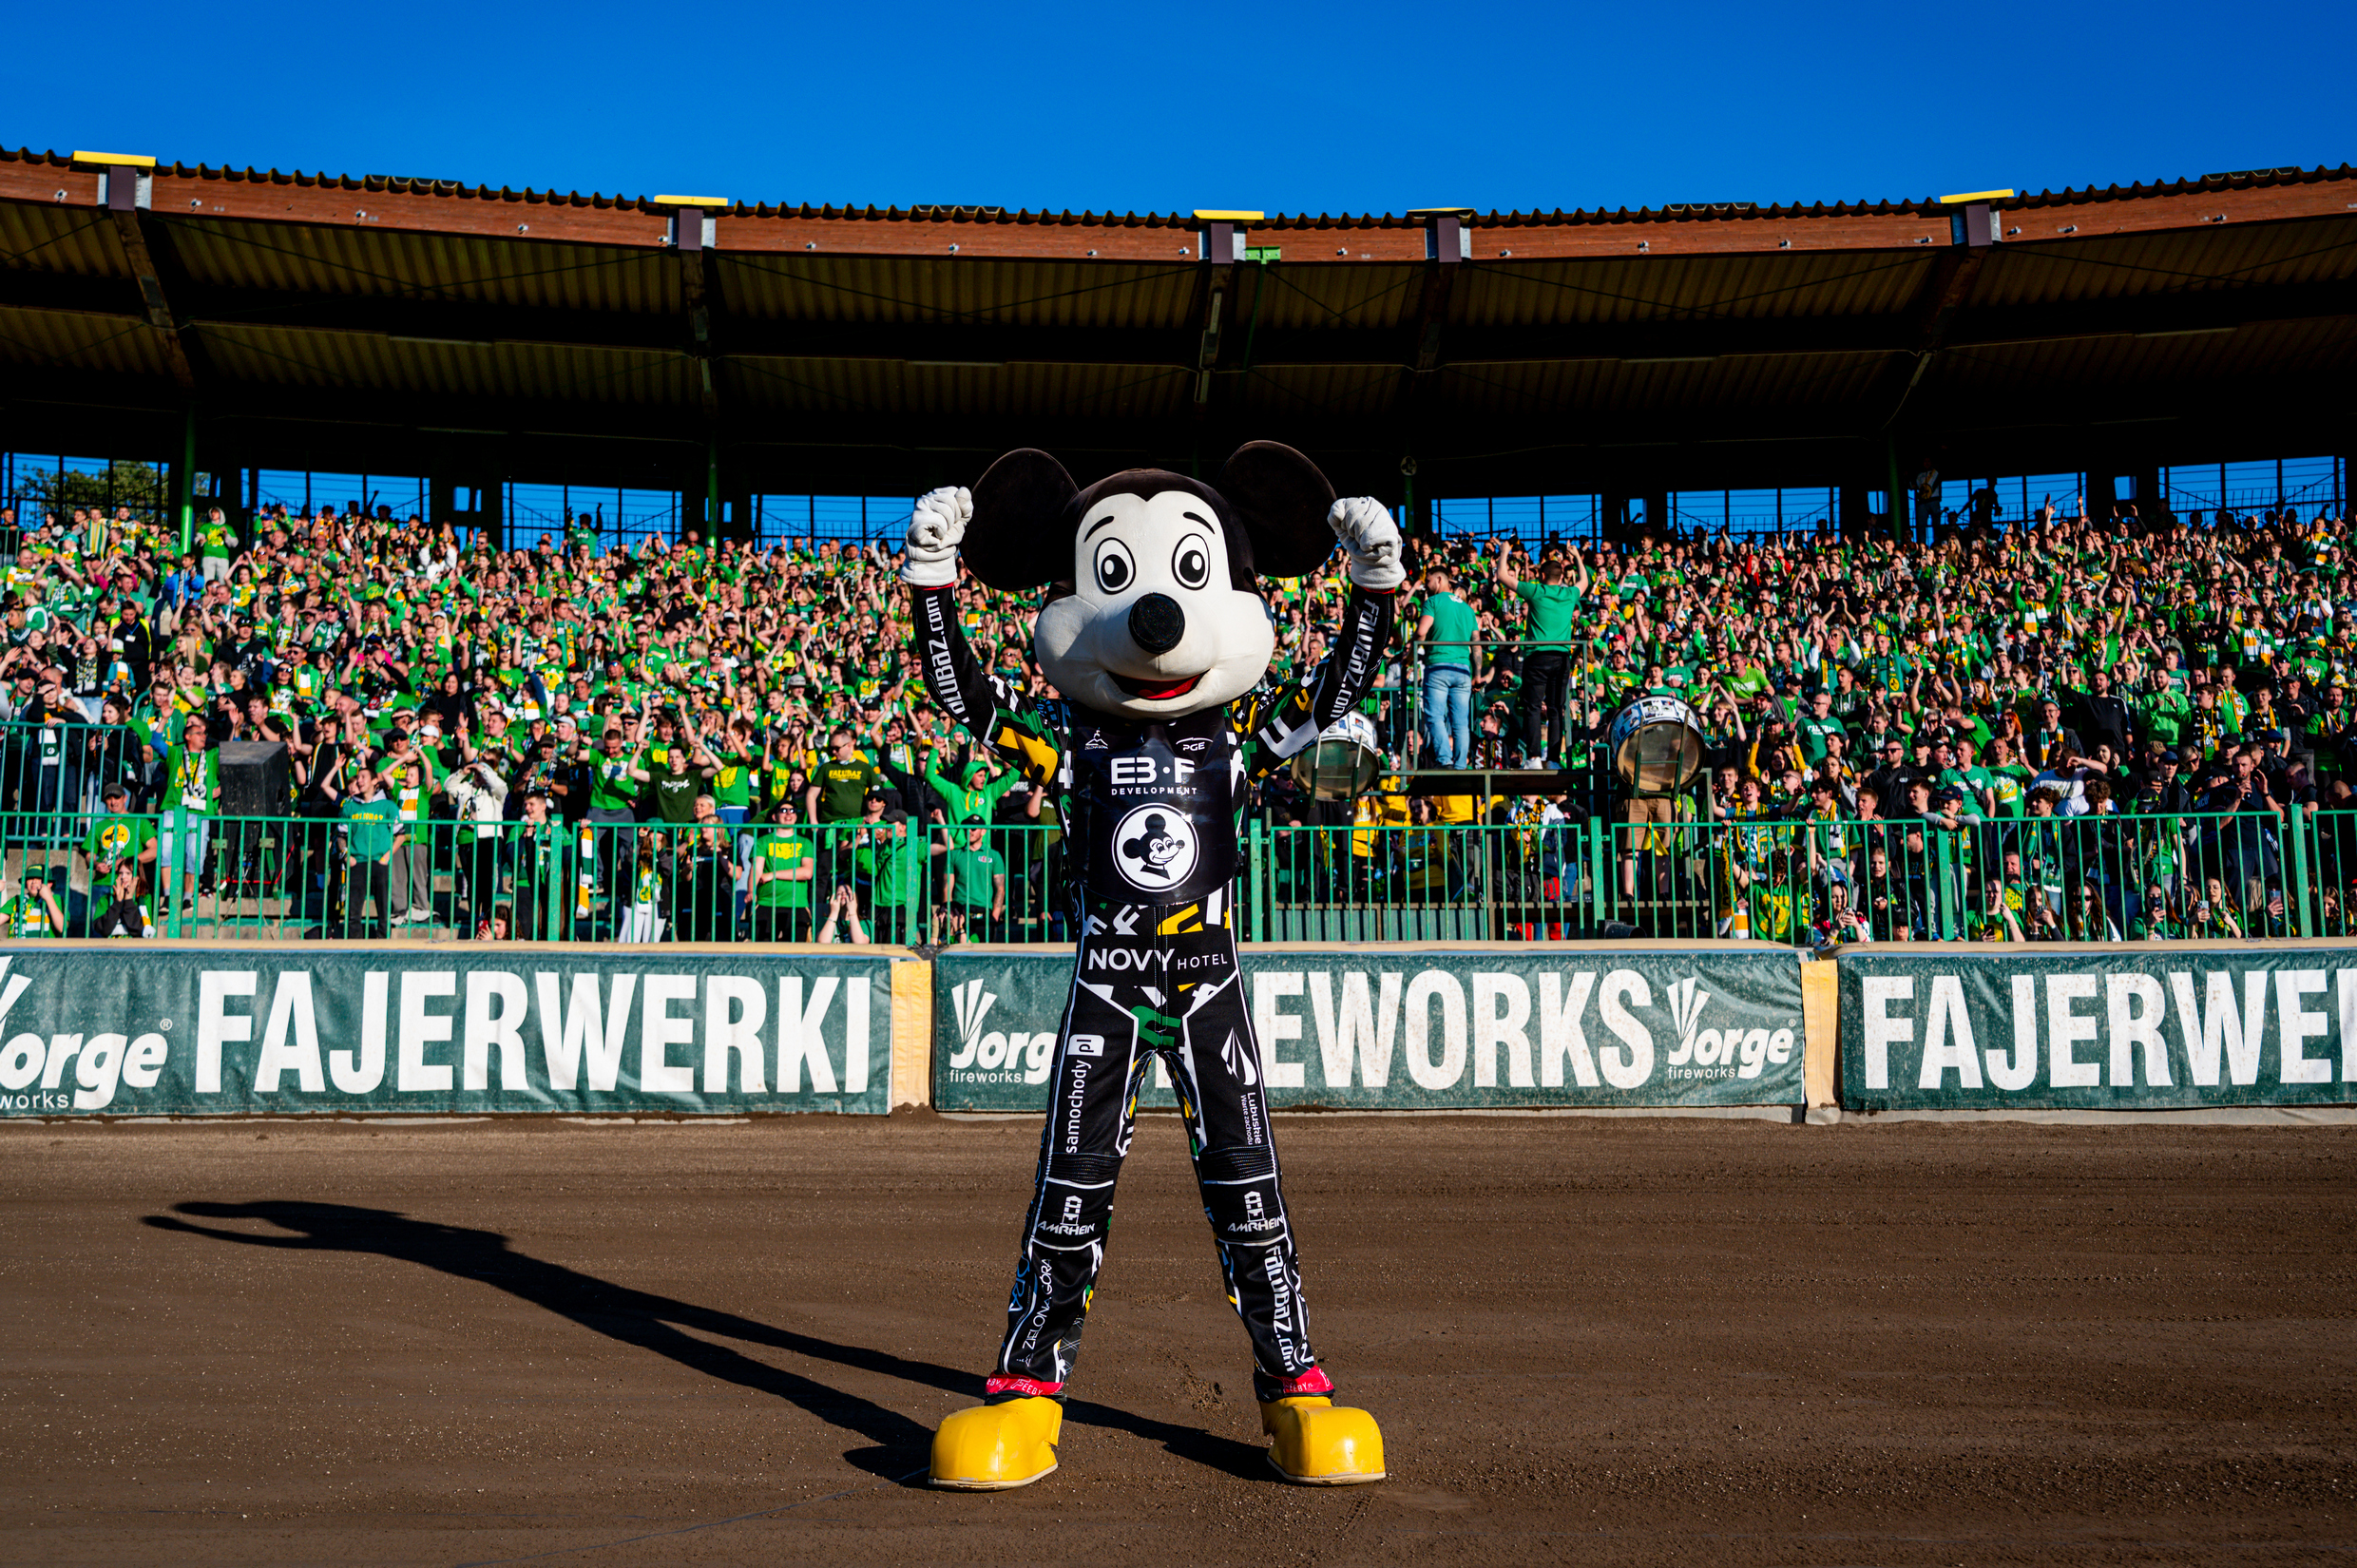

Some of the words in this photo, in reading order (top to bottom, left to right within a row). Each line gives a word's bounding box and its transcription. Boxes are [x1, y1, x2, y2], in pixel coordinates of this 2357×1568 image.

[1182, 741, 1205, 752] PGE
[1111, 787, 1198, 795] DEVELOPMENT
[1088, 948, 1175, 971] NOVY
[1177, 953, 1228, 970] HOTEL
[196, 971, 872, 1094] FAJERWERKI
[1253, 969, 1655, 1090] EWORKS
[949, 1020, 1058, 1084] Jorg
[949, 1069, 1022, 1083] fireworks
[1668, 1065, 1735, 1080] fireworks
[0, 1090, 69, 1109] works
[1065, 1059, 1092, 1154] samochody
[1240, 1095, 1249, 1116] Warte
[1247, 1092, 1262, 1144] Lubuskie
[1037, 1220, 1095, 1235] AMRHEIN
[1227, 1214, 1284, 1233] AMRHEIN
[1022, 1296, 1052, 1350] ZIELONA
